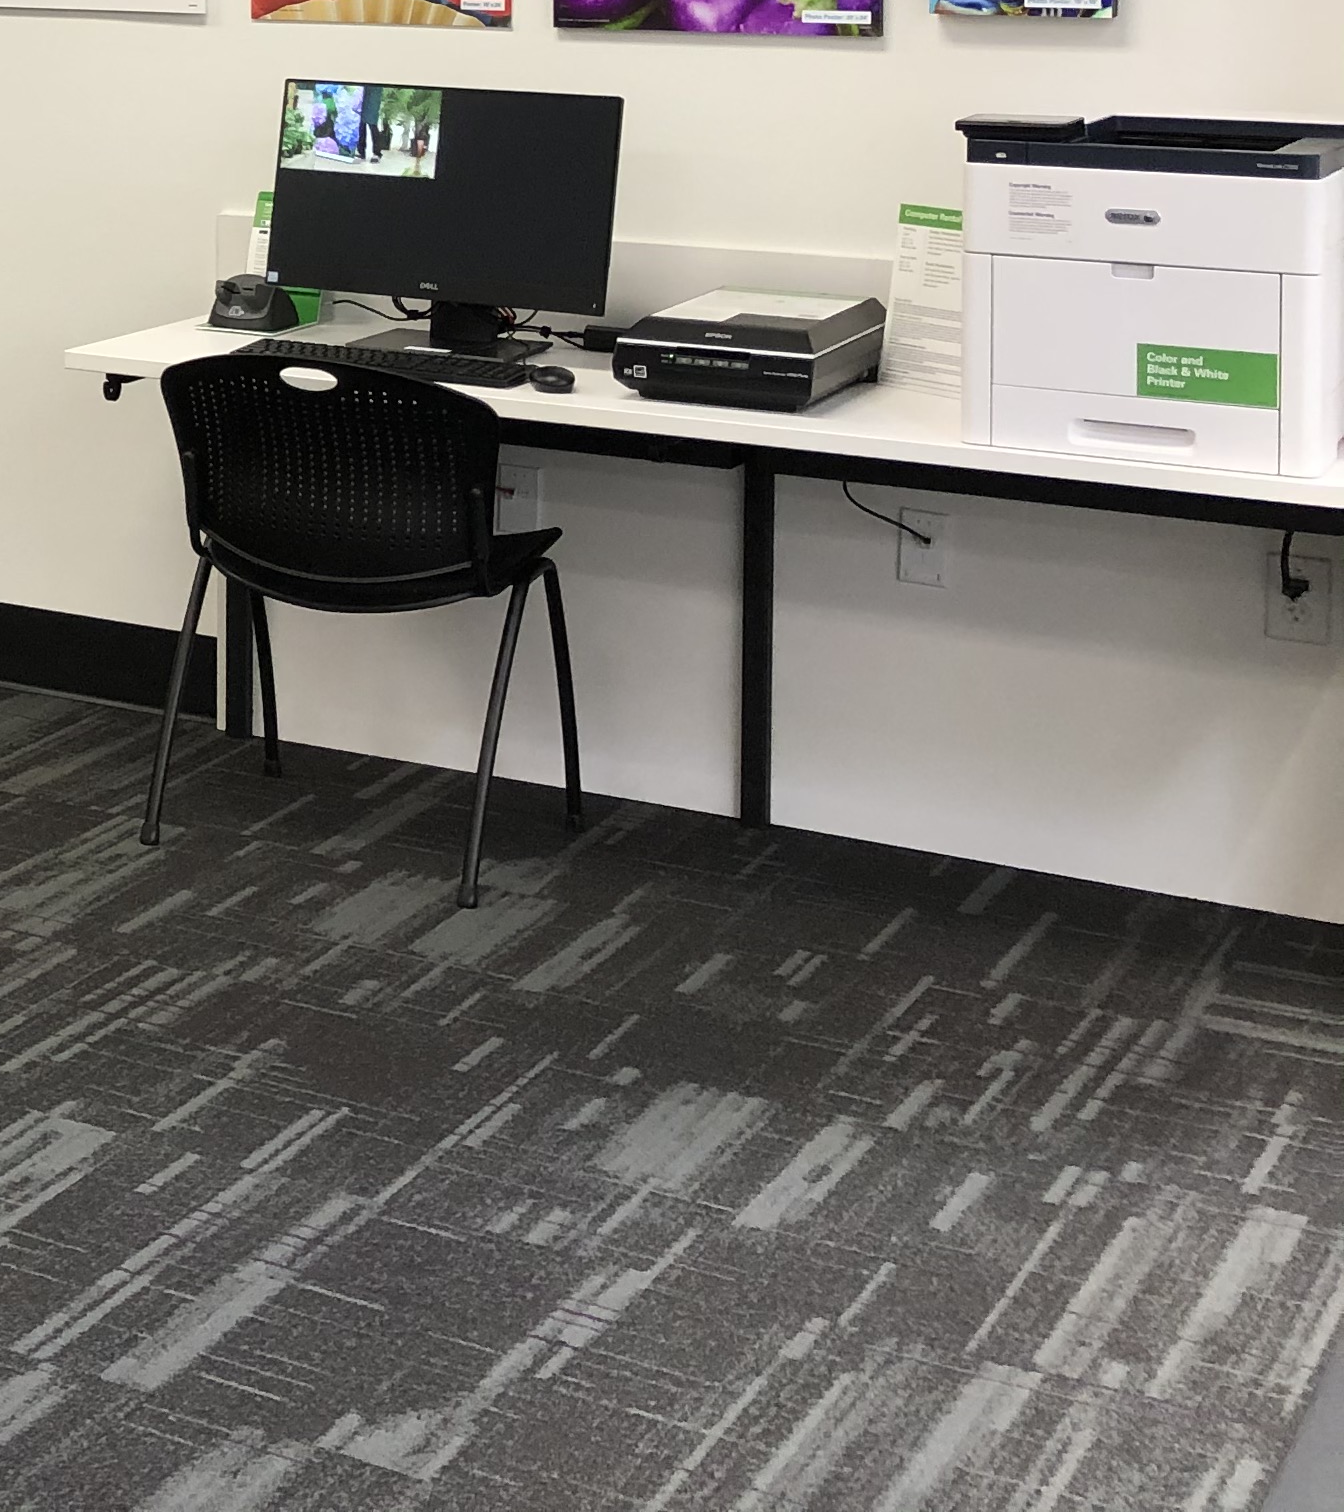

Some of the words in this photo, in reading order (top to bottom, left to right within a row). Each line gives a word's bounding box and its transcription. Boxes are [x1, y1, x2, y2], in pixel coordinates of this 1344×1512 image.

[419, 281, 439, 291] DELL
[1146, 351, 1178, 364] Color
[1180, 355, 1204, 367] and
[1146, 364, 1178, 376] Black
[1180, 366, 1191, 377] &
[1194, 367, 1230, 380] White
[1146, 375, 1186, 389] Printer
